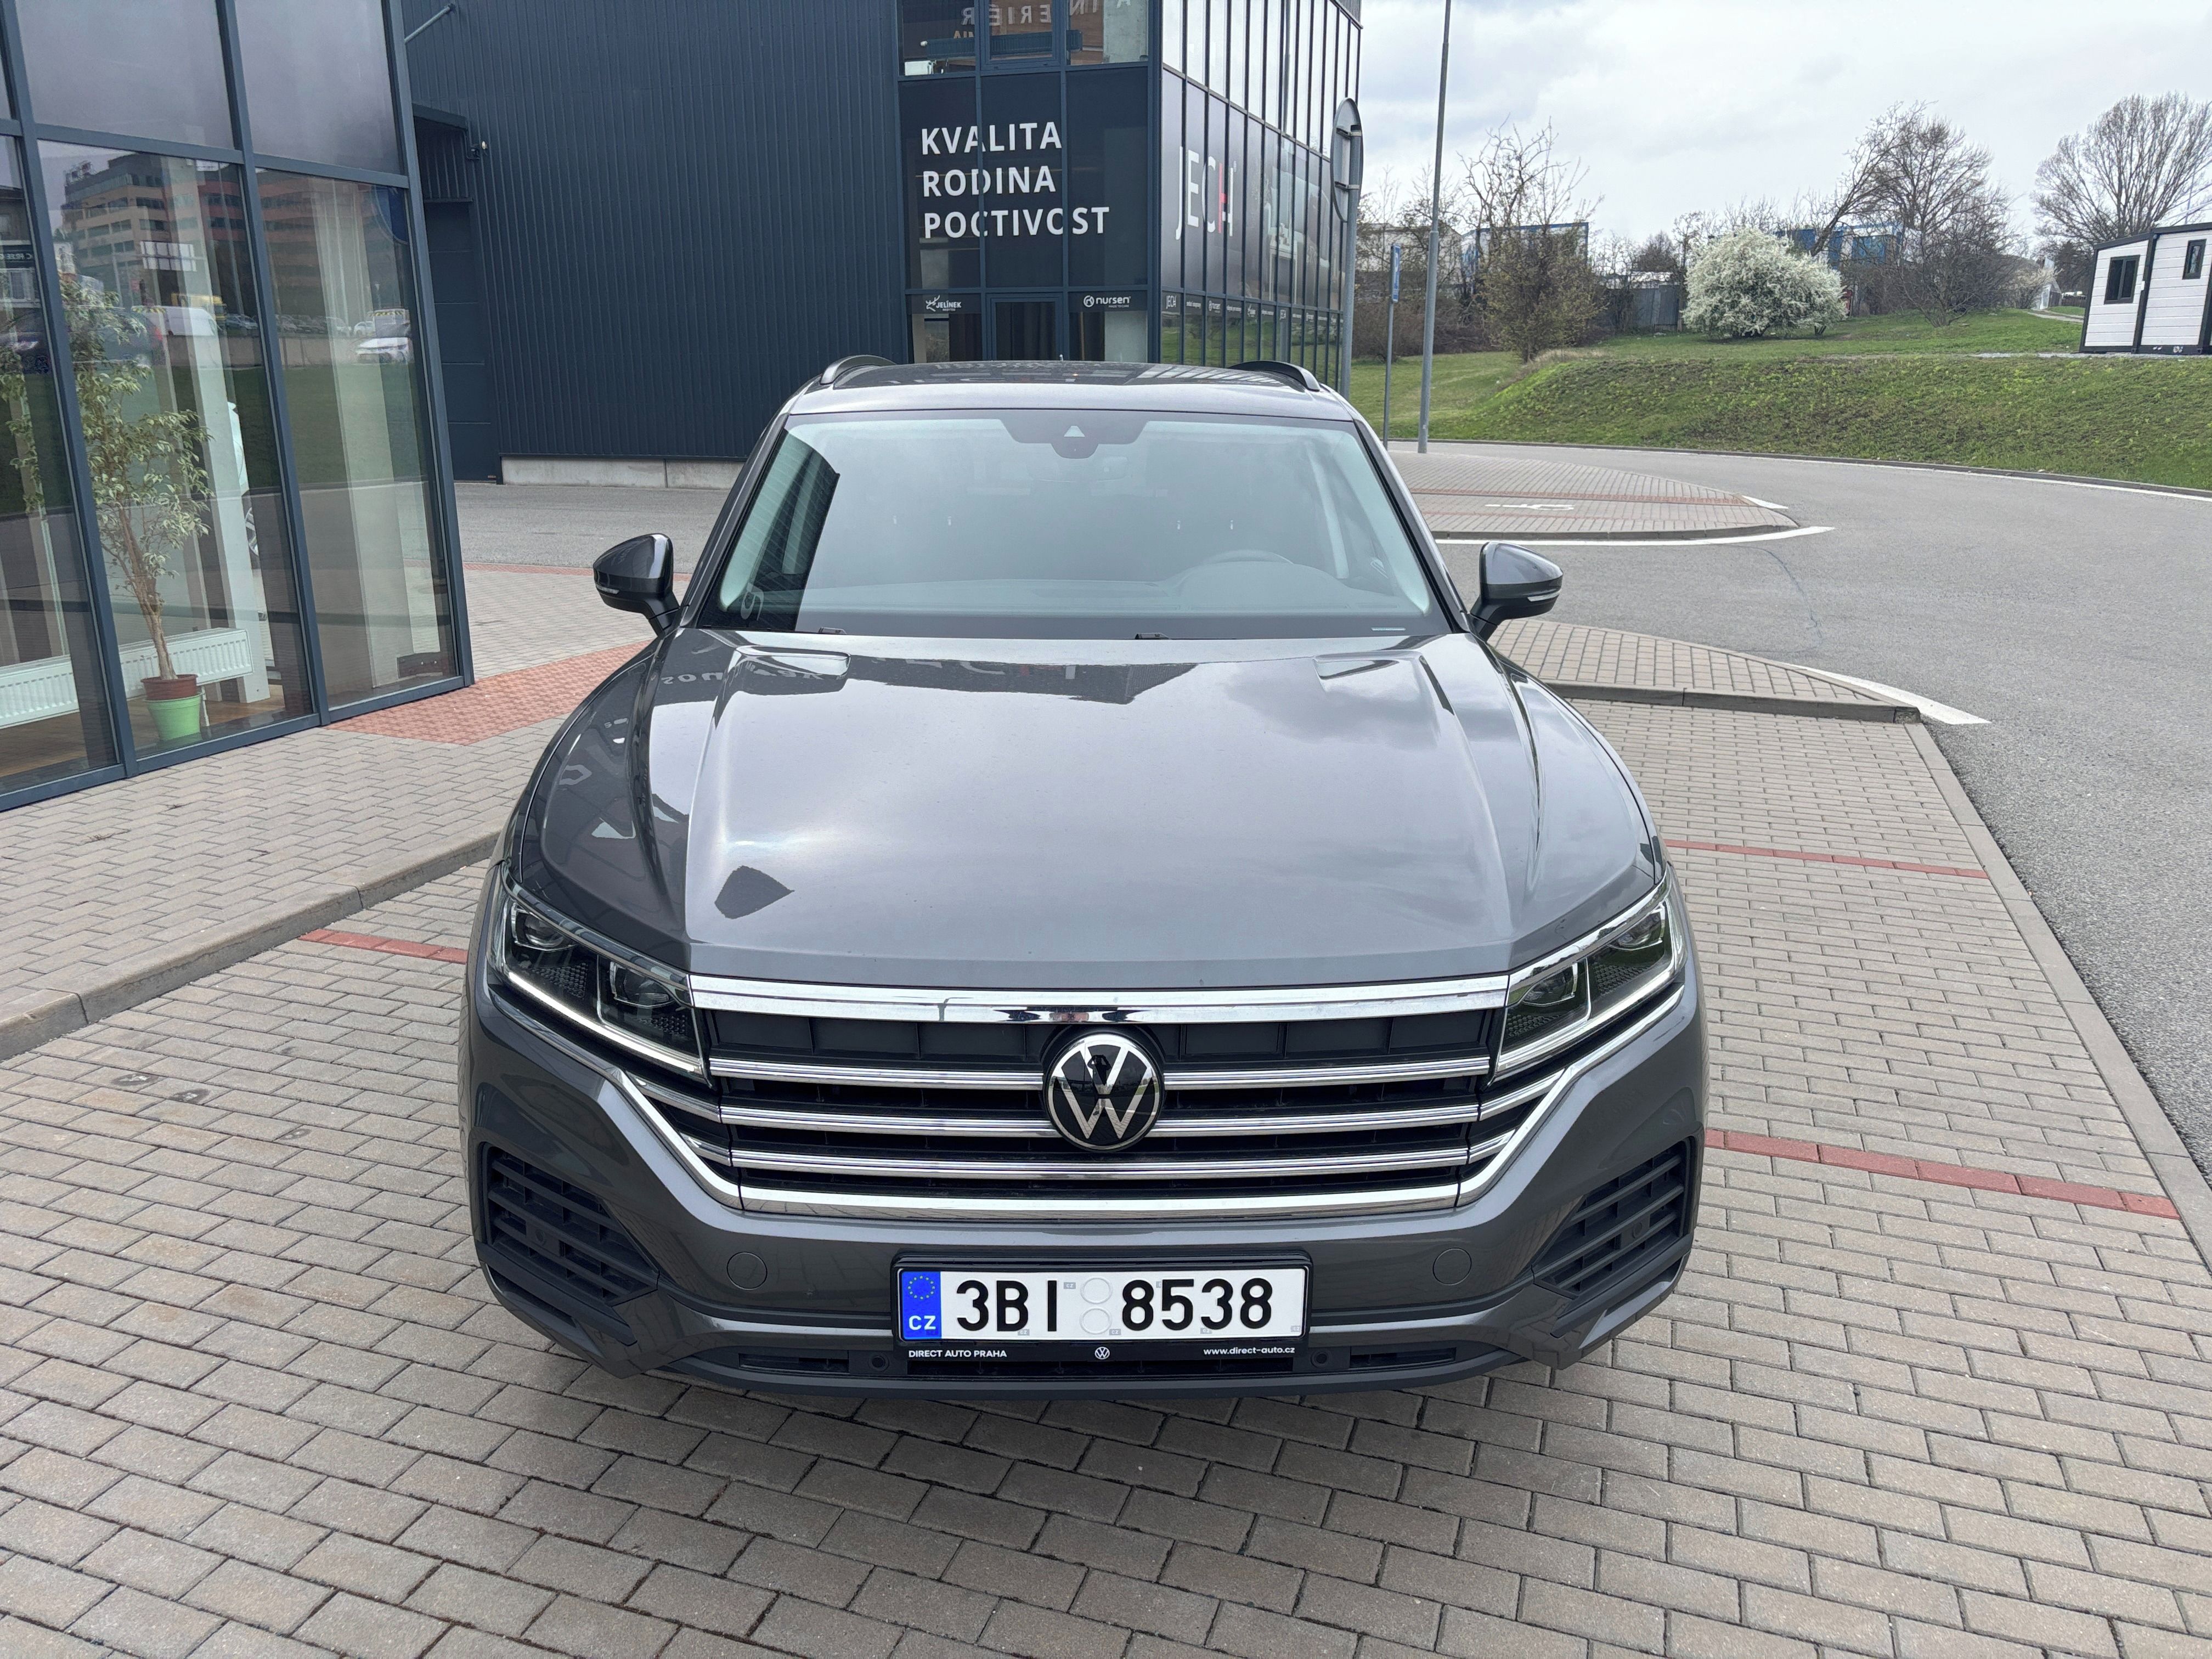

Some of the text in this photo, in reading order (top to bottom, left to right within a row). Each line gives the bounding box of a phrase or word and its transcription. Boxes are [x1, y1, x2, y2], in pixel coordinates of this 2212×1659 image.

[922, 122, 1062, 155] KVALITA
[923, 166, 1056, 197] RODINA
[924, 207, 1109, 239] POCTIVOST
[936, 300, 962, 308] JELÍNEK
[957, 1278, 1272, 1332] 3BI 8538
[909, 1316, 936, 1330] CZ
[974, 1350, 1007, 1358] PRAHA
[1203, 1346, 1295, 1355] www.direct-auto.cz
